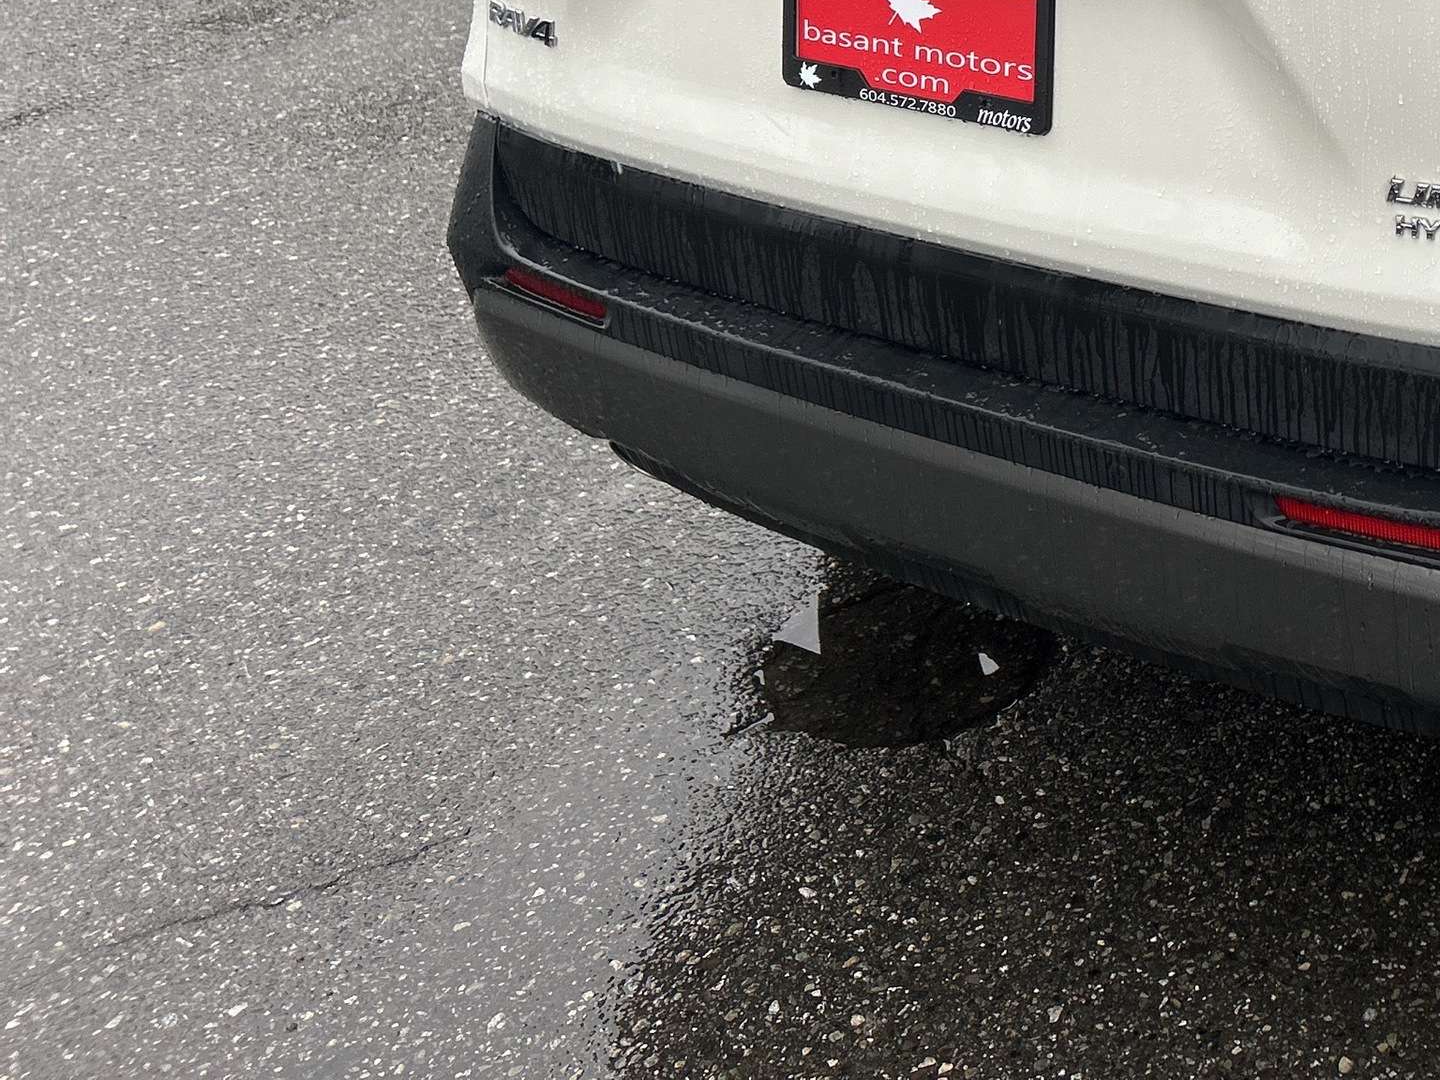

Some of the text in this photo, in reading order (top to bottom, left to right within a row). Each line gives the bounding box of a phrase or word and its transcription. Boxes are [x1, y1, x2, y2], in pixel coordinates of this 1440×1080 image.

[489, 0, 557, 48] RAV4
[803, 19, 1034, 81] basant motors
[874, 67, 950, 94] .com
[859, 88, 957, 118] 604.572.7880
[977, 107, 1032, 133] motors
